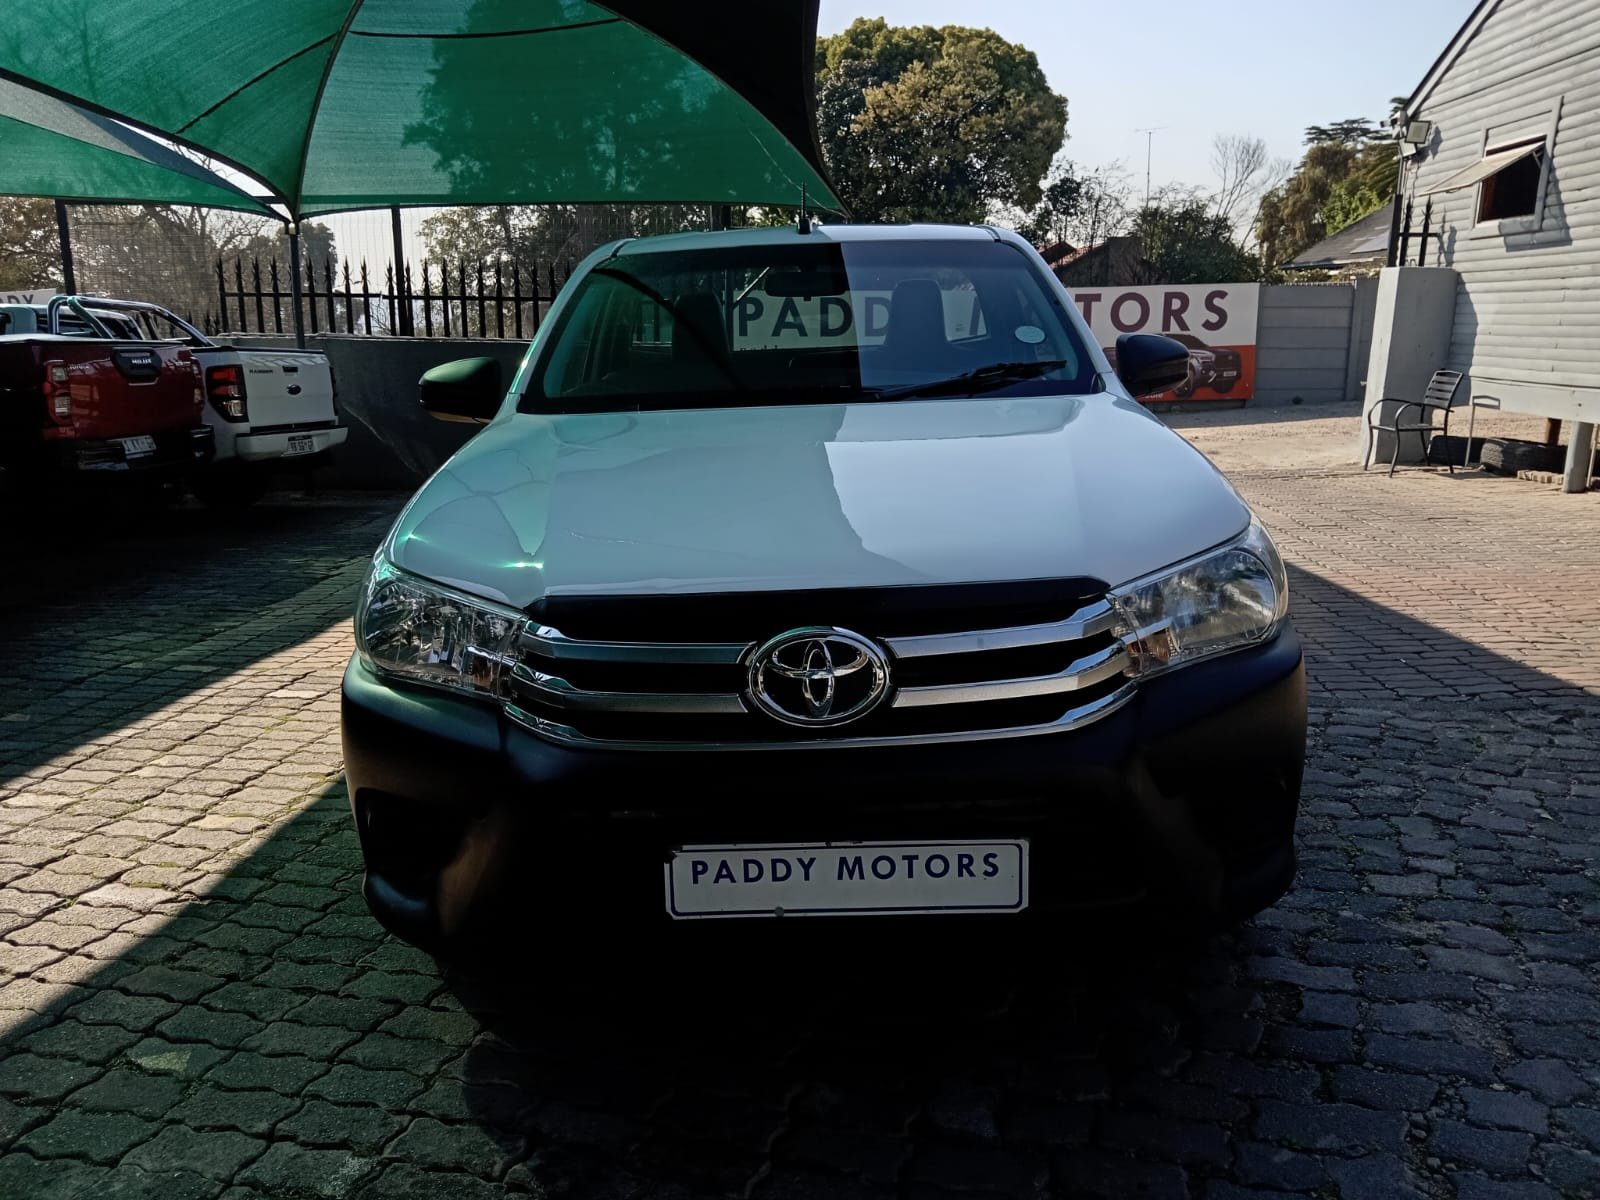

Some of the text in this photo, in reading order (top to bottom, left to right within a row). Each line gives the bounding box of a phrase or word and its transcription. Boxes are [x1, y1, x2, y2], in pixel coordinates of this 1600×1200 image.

[738, 289, 1229, 337] PADD TORS
[691, 852, 1000, 885] PADDY MOTORS
